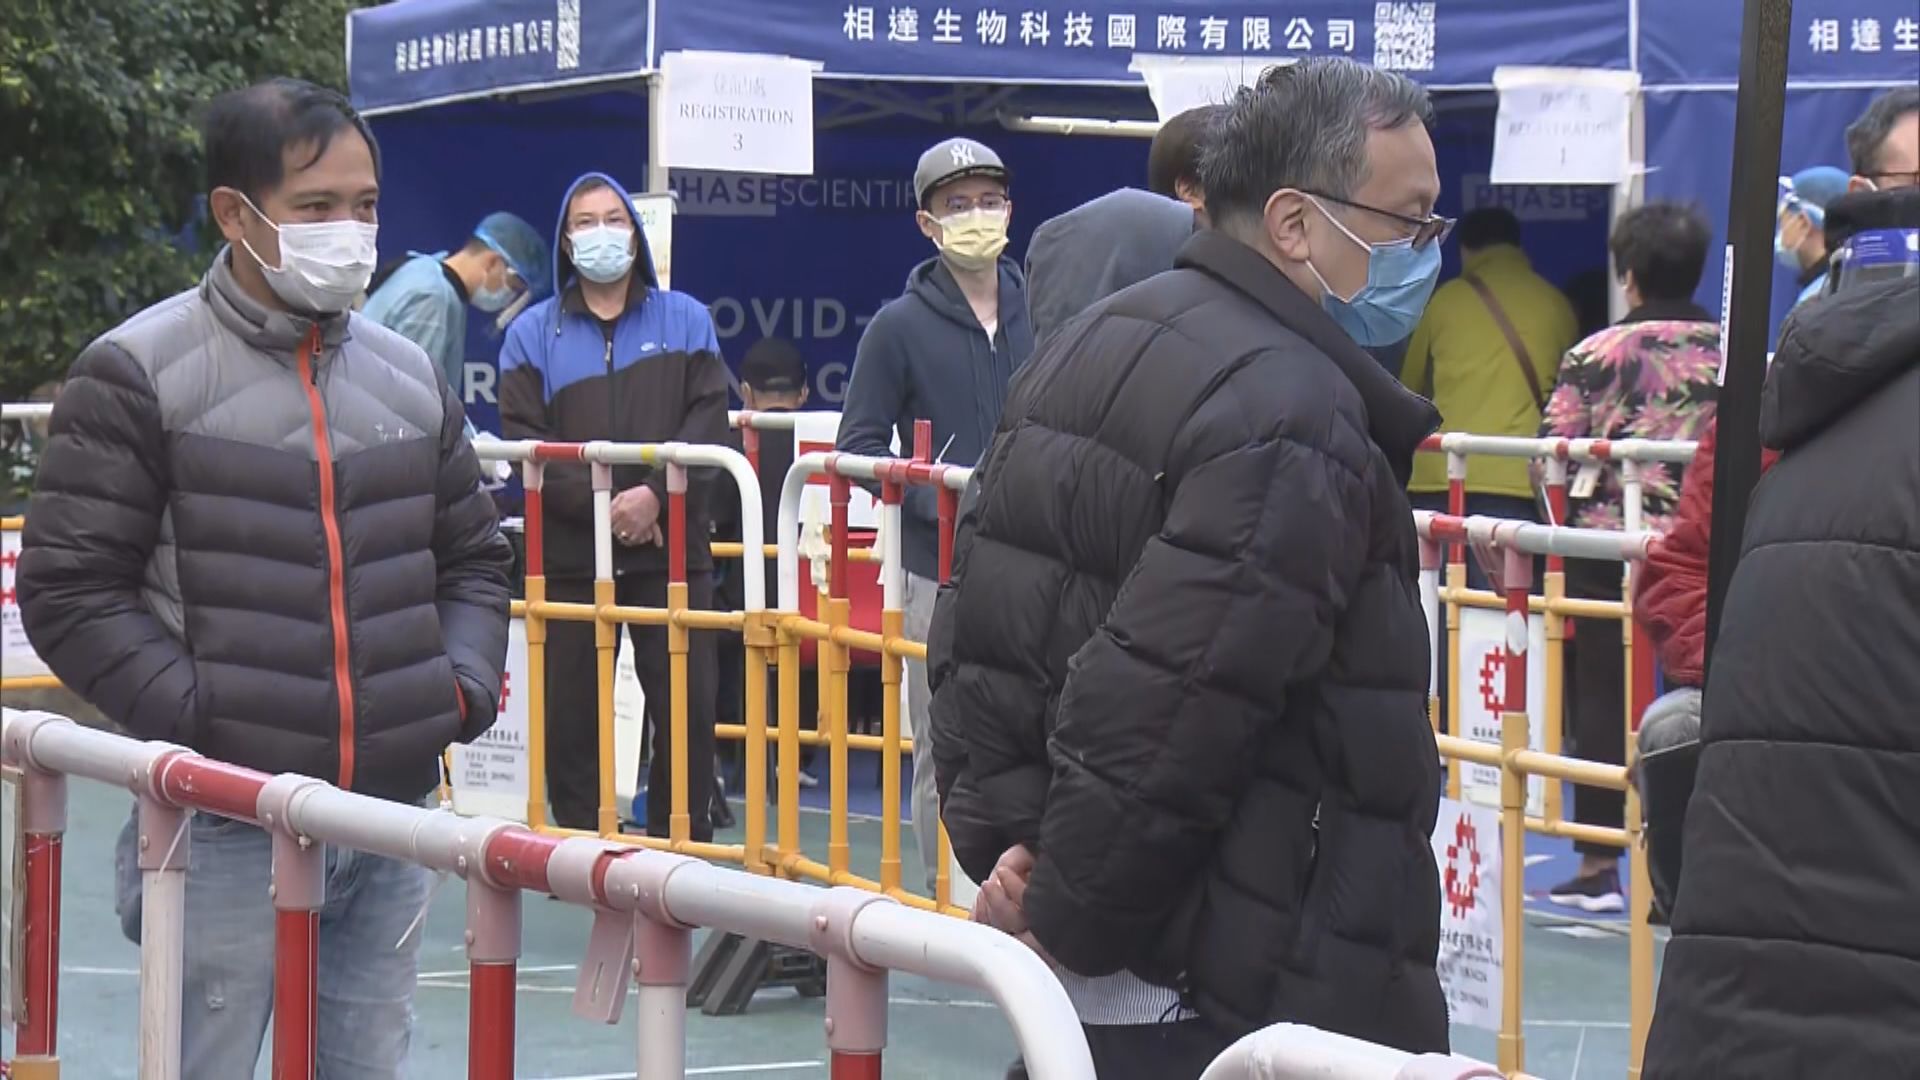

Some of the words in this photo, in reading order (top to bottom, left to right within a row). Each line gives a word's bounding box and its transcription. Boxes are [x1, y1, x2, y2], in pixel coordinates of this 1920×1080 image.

[843, 4, 1356, 51] 相達生物科技國際有限公司
[1808, 17, 1918, 52] 相達生
[679, 102, 794, 124] REGISTRATION
[732, 131, 744, 152] 3
